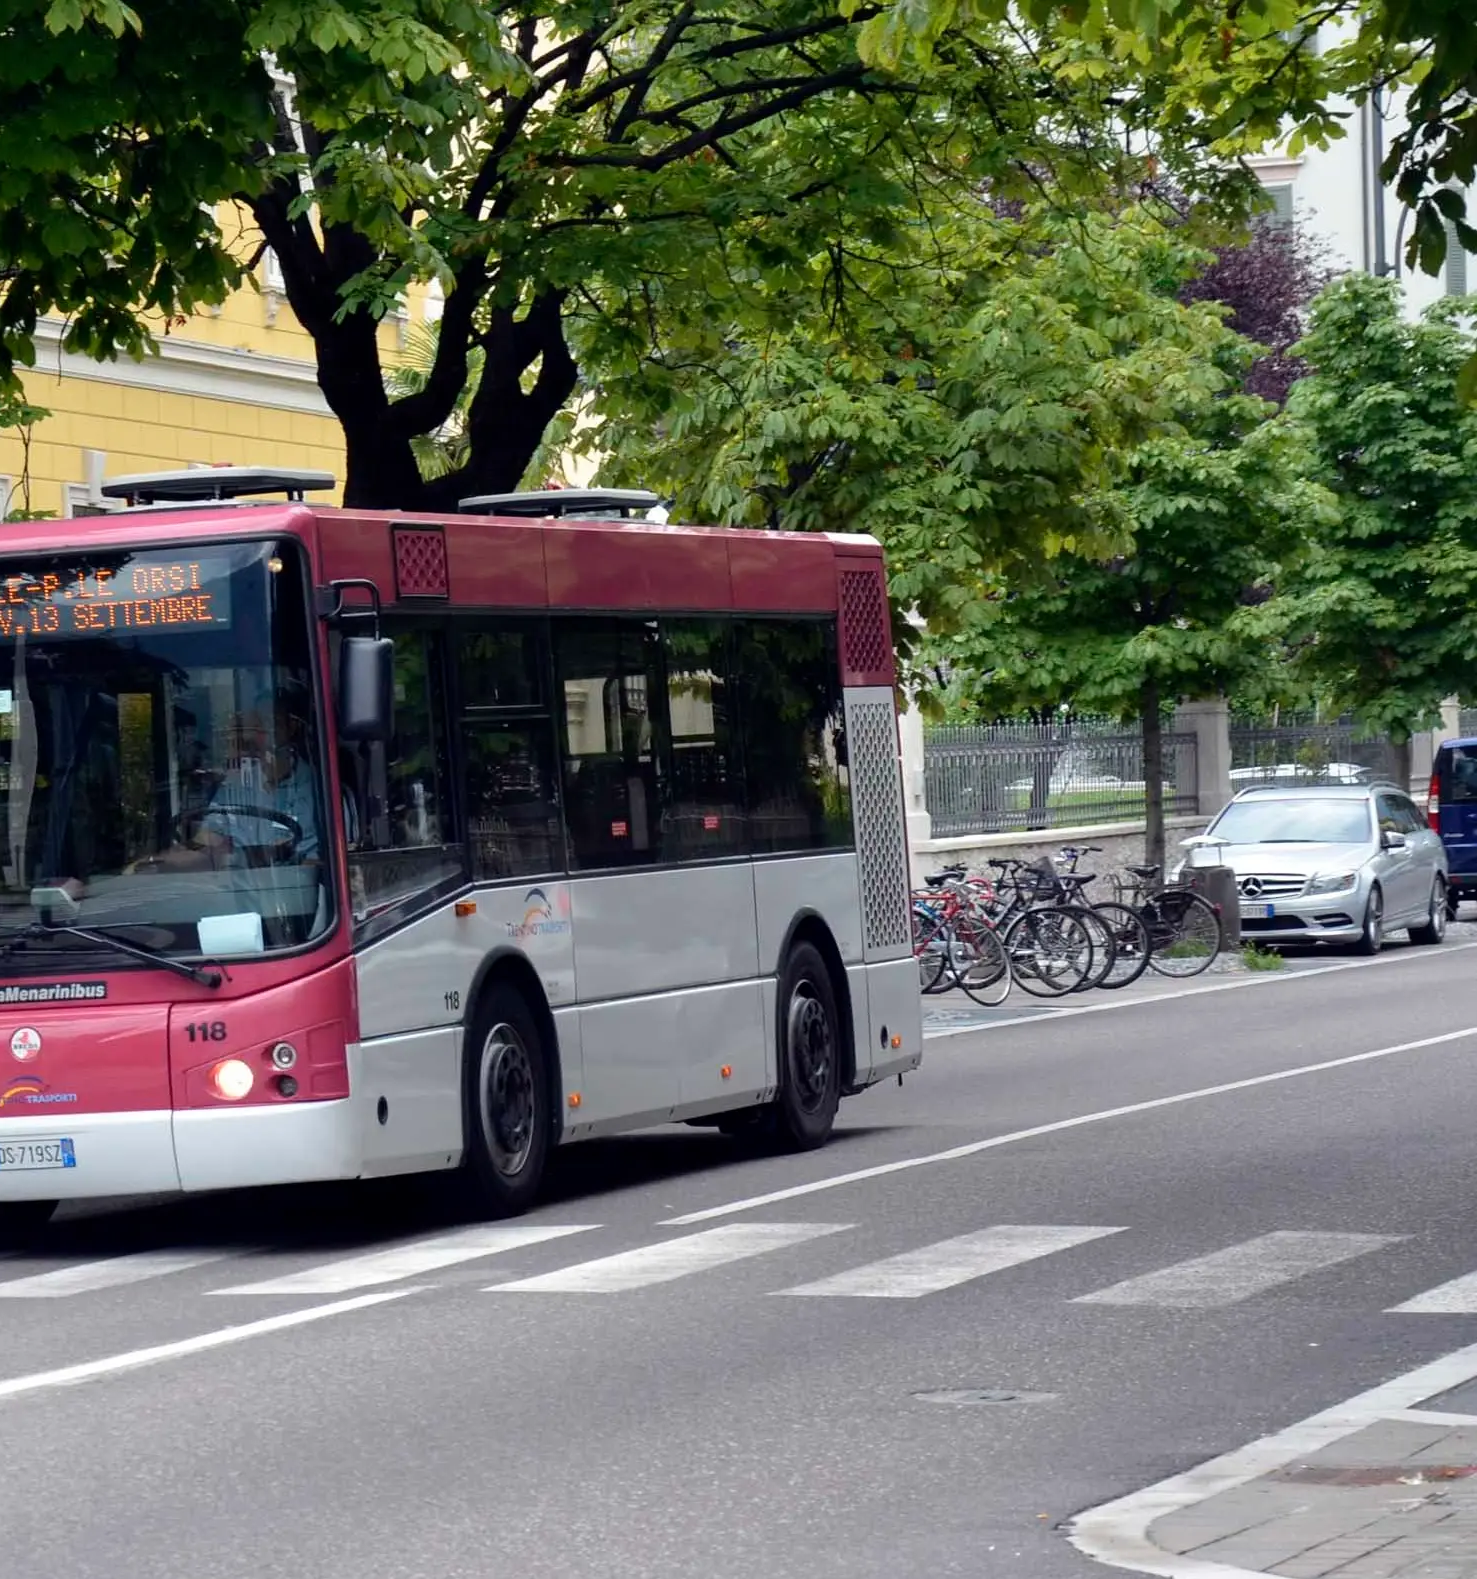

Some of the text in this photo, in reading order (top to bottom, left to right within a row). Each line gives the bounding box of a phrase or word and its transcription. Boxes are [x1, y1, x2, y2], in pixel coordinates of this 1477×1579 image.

[132, 564, 201, 594] ORSI
[74, 595, 213, 630] SETTEMBRE
[444, 991, 460, 1011] 118
[184, 1021, 228, 1042] 118
